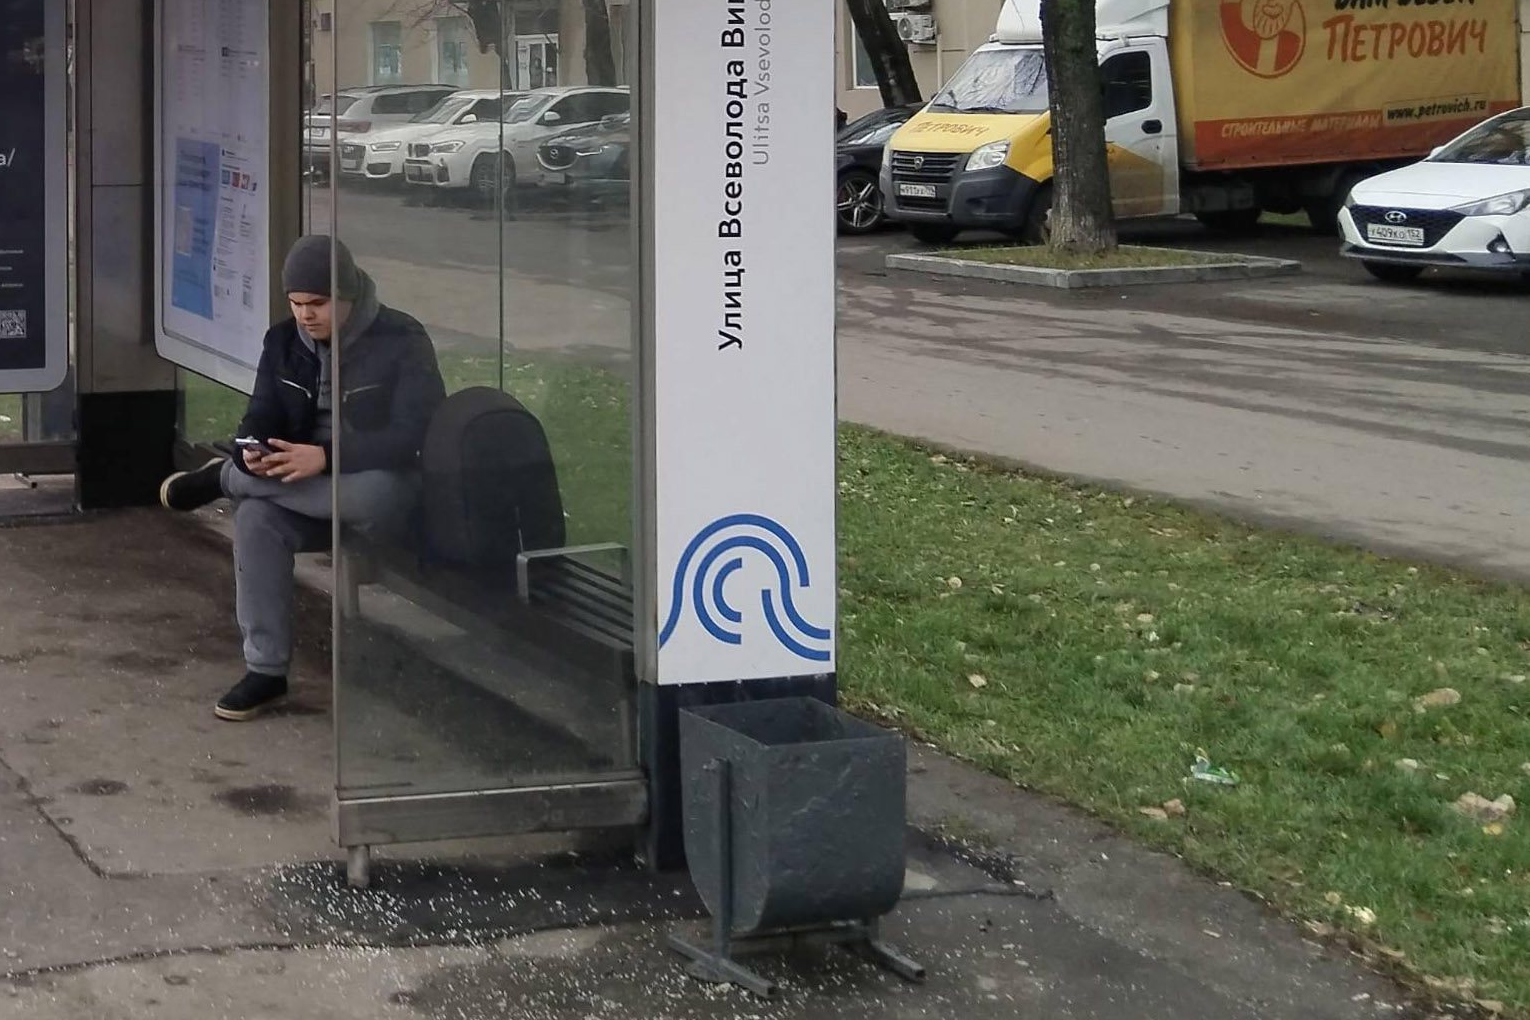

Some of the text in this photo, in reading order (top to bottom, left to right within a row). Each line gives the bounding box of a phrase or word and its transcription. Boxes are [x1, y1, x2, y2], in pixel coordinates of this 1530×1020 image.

[1322, 13, 1488, 63] ПЕТРОВИЧ
[752, 101, 770, 166] Ulitsa
[1221, 114, 1380, 138] СТРОИТЕЛЬНЫЕ МАТЕРИАЛЫ
[1387, 97, 1487, 122] www.petrovich.ru
[718, 59, 748, 238] Всеволода
[717, 249, 745, 351] Улица
